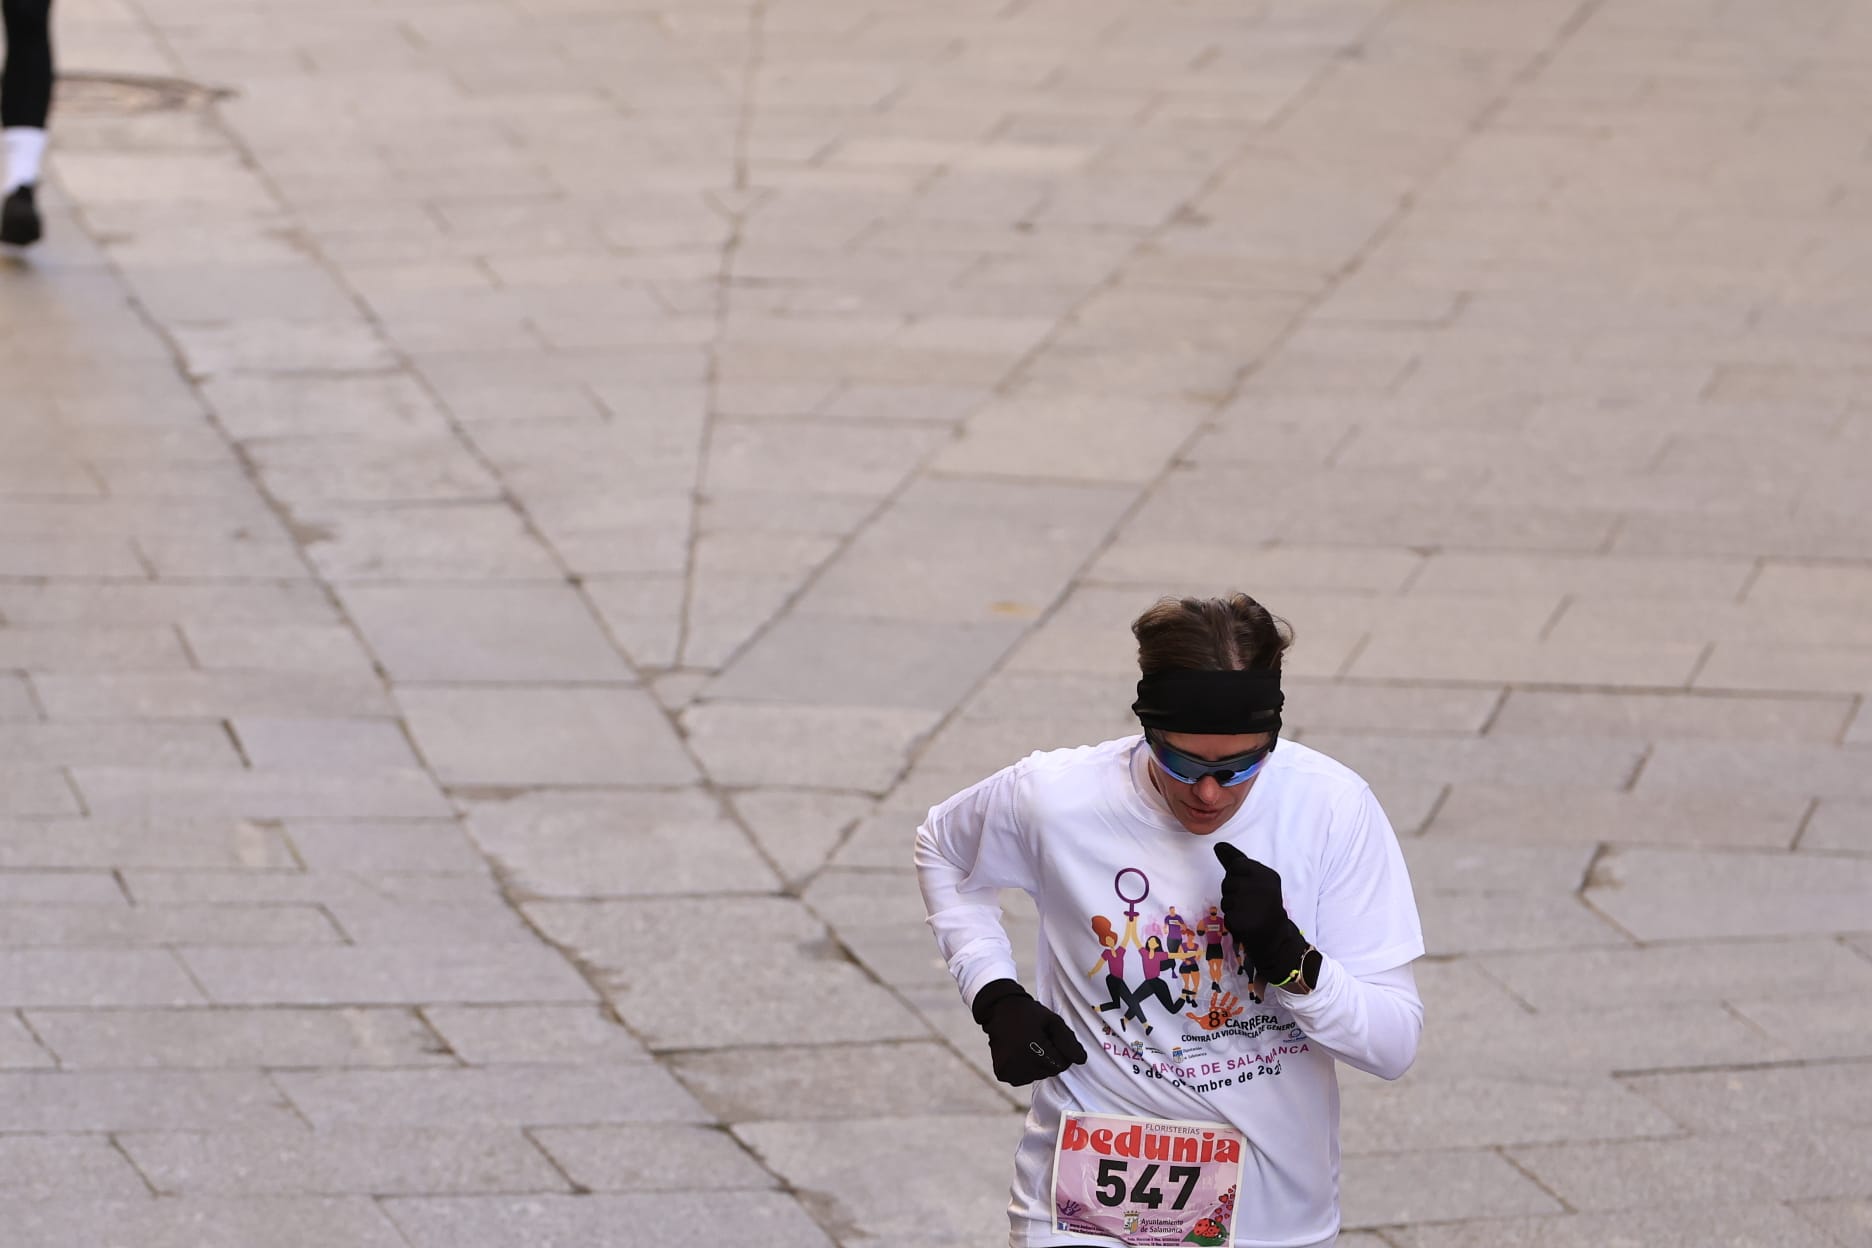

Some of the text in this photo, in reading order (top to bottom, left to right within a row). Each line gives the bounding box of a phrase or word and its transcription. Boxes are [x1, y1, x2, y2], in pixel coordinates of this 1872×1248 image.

[1225, 1015, 1278, 1031] CARRERA
[1181, 1034, 1211, 1042] CONTRA
[1211, 1031, 1221, 1040] LA
[1220, 1028, 1259, 1039] VIOLENCIA
[1103, 1042, 1144, 1061] PLAZ
[1201, 1062, 1220, 1075] DE
[1227, 1043, 1309, 1070] SALAMANCA
[1133, 1064, 1140, 1074] 9
[1238, 1072, 1253, 1083] de
[1258, 1060, 1281, 1075] 202
[1145, 1123, 1200, 1135] FLORISTERÍAS
[1062, 1119, 1240, 1163] bedunia
[1095, 1158, 1201, 1210] 547
[1140, 1217, 1183, 1228] Ayuntamiento
[1149, 1225, 1183, 1234] Salamanca
